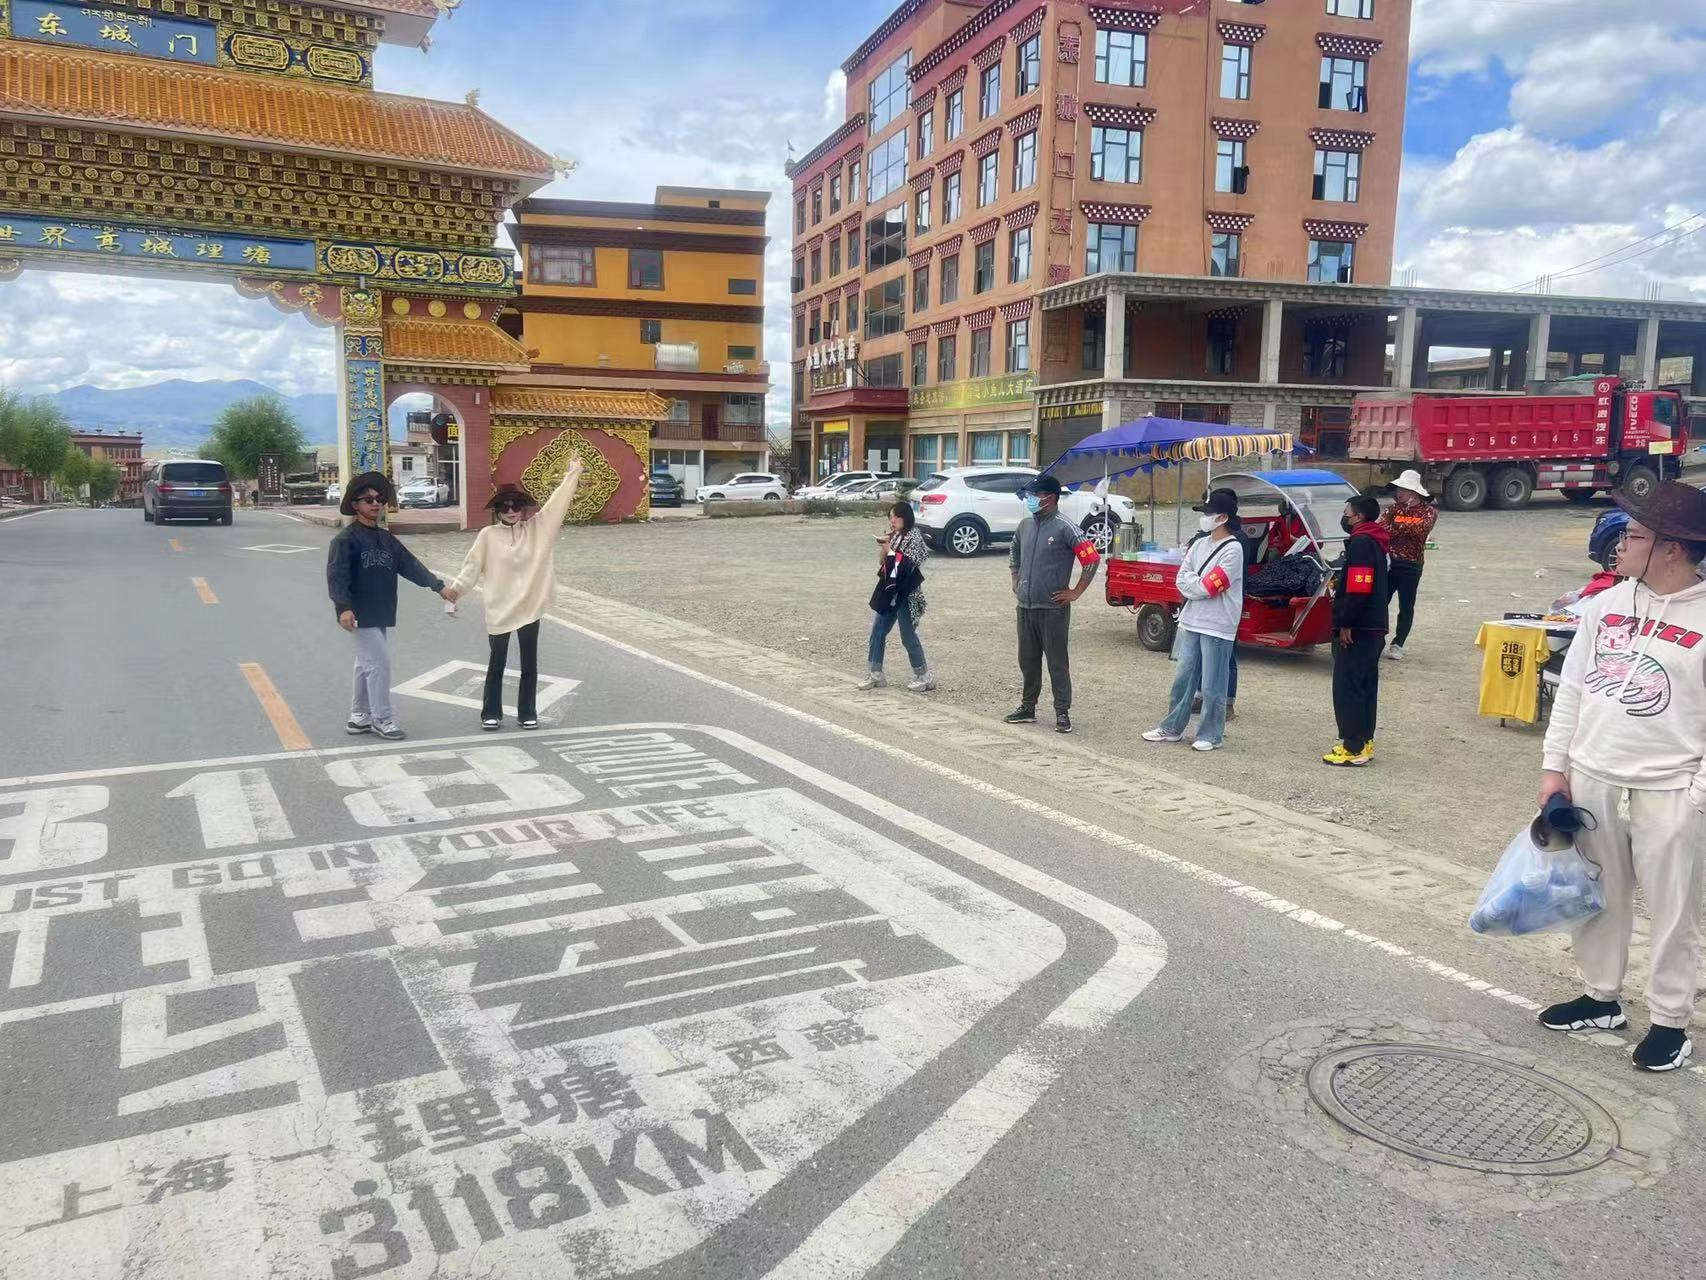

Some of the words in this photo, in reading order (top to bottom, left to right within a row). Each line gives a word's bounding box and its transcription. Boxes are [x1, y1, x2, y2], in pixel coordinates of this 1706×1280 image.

[34, 12, 198, 56] 东城门
[1629, 395, 1639, 431] IVECO
[1502, 642, 1519, 654] 318
[171, 854, 276, 889] GO
[309, 841, 381, 870] IN
[405, 816, 583, 855] YOUR
[600, 801, 729, 831] LIFE
[320, 1111, 768, 1280] 3118KM
